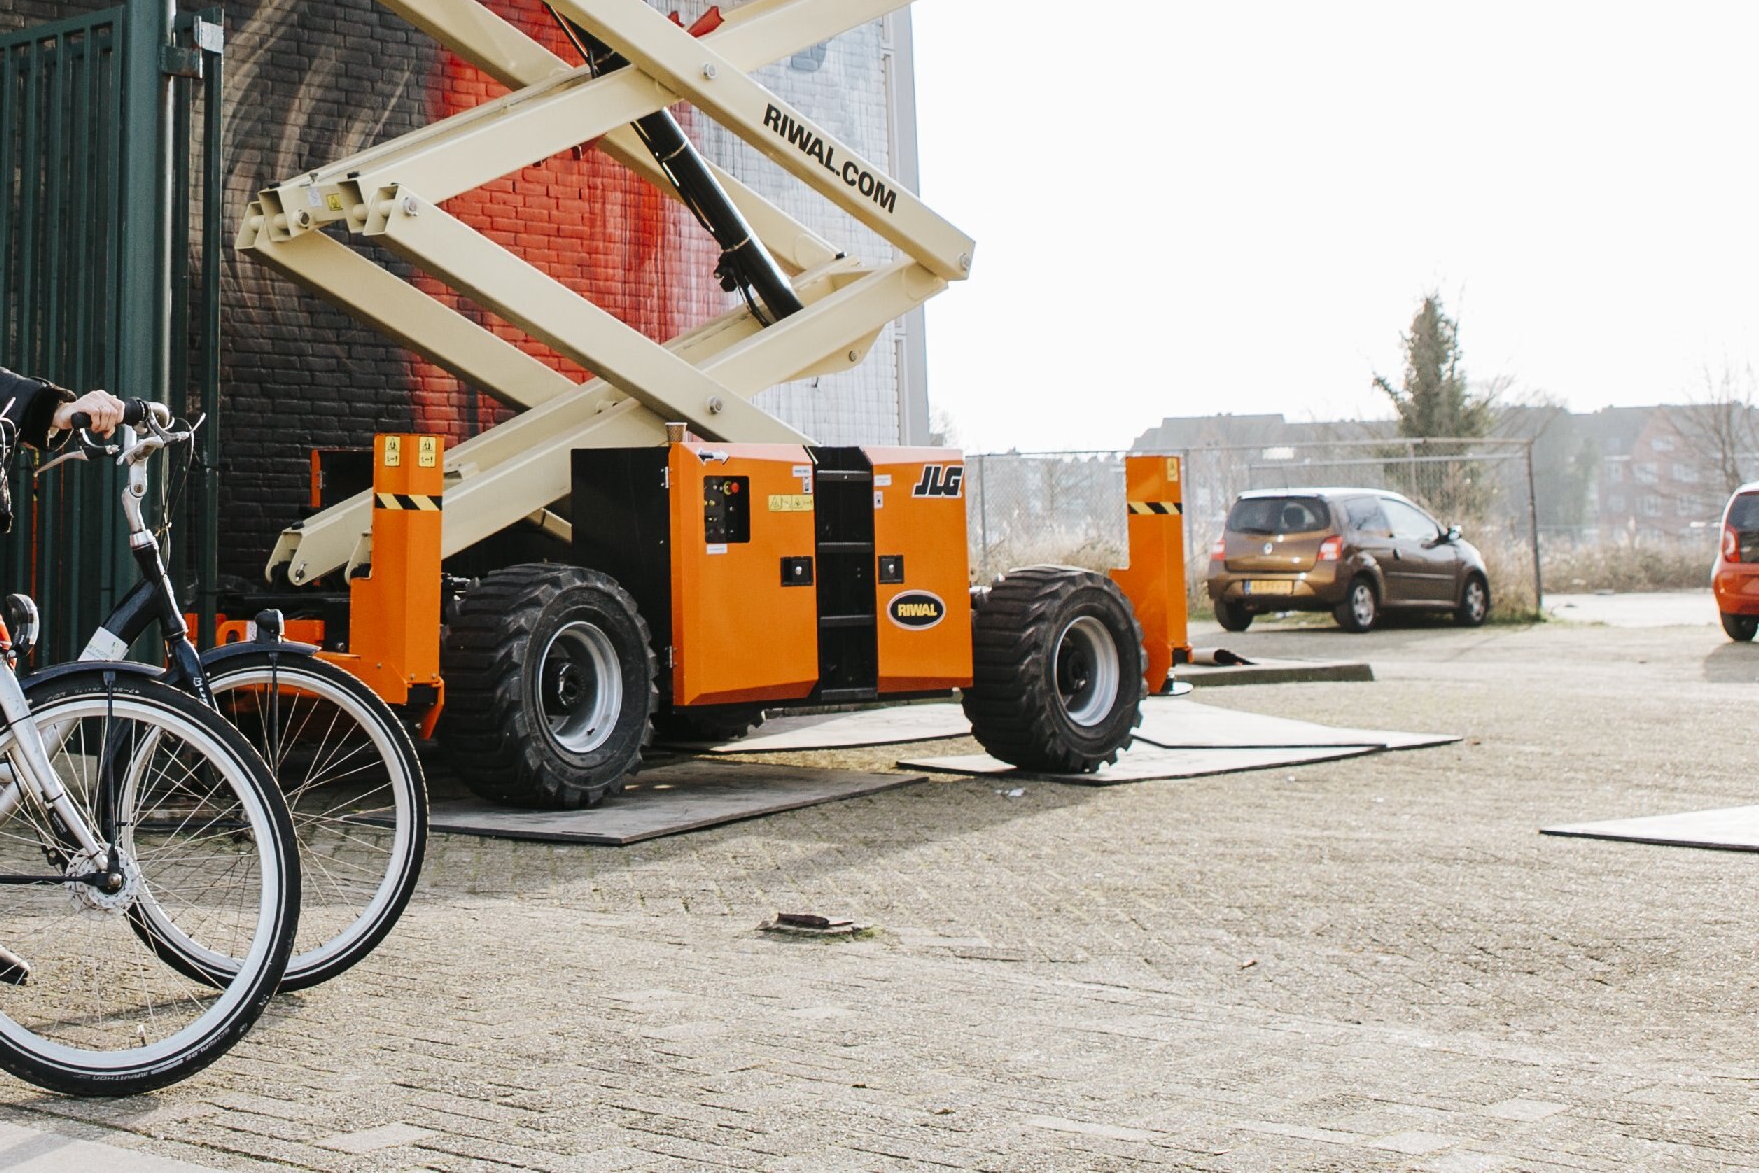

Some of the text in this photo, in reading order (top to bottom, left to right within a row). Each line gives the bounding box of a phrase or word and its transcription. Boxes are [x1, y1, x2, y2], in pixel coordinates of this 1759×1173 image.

[762, 103, 897, 214] RIWAL.COM
[914, 465, 964, 496] JLG
[897, 603, 938, 618] RIWAL
